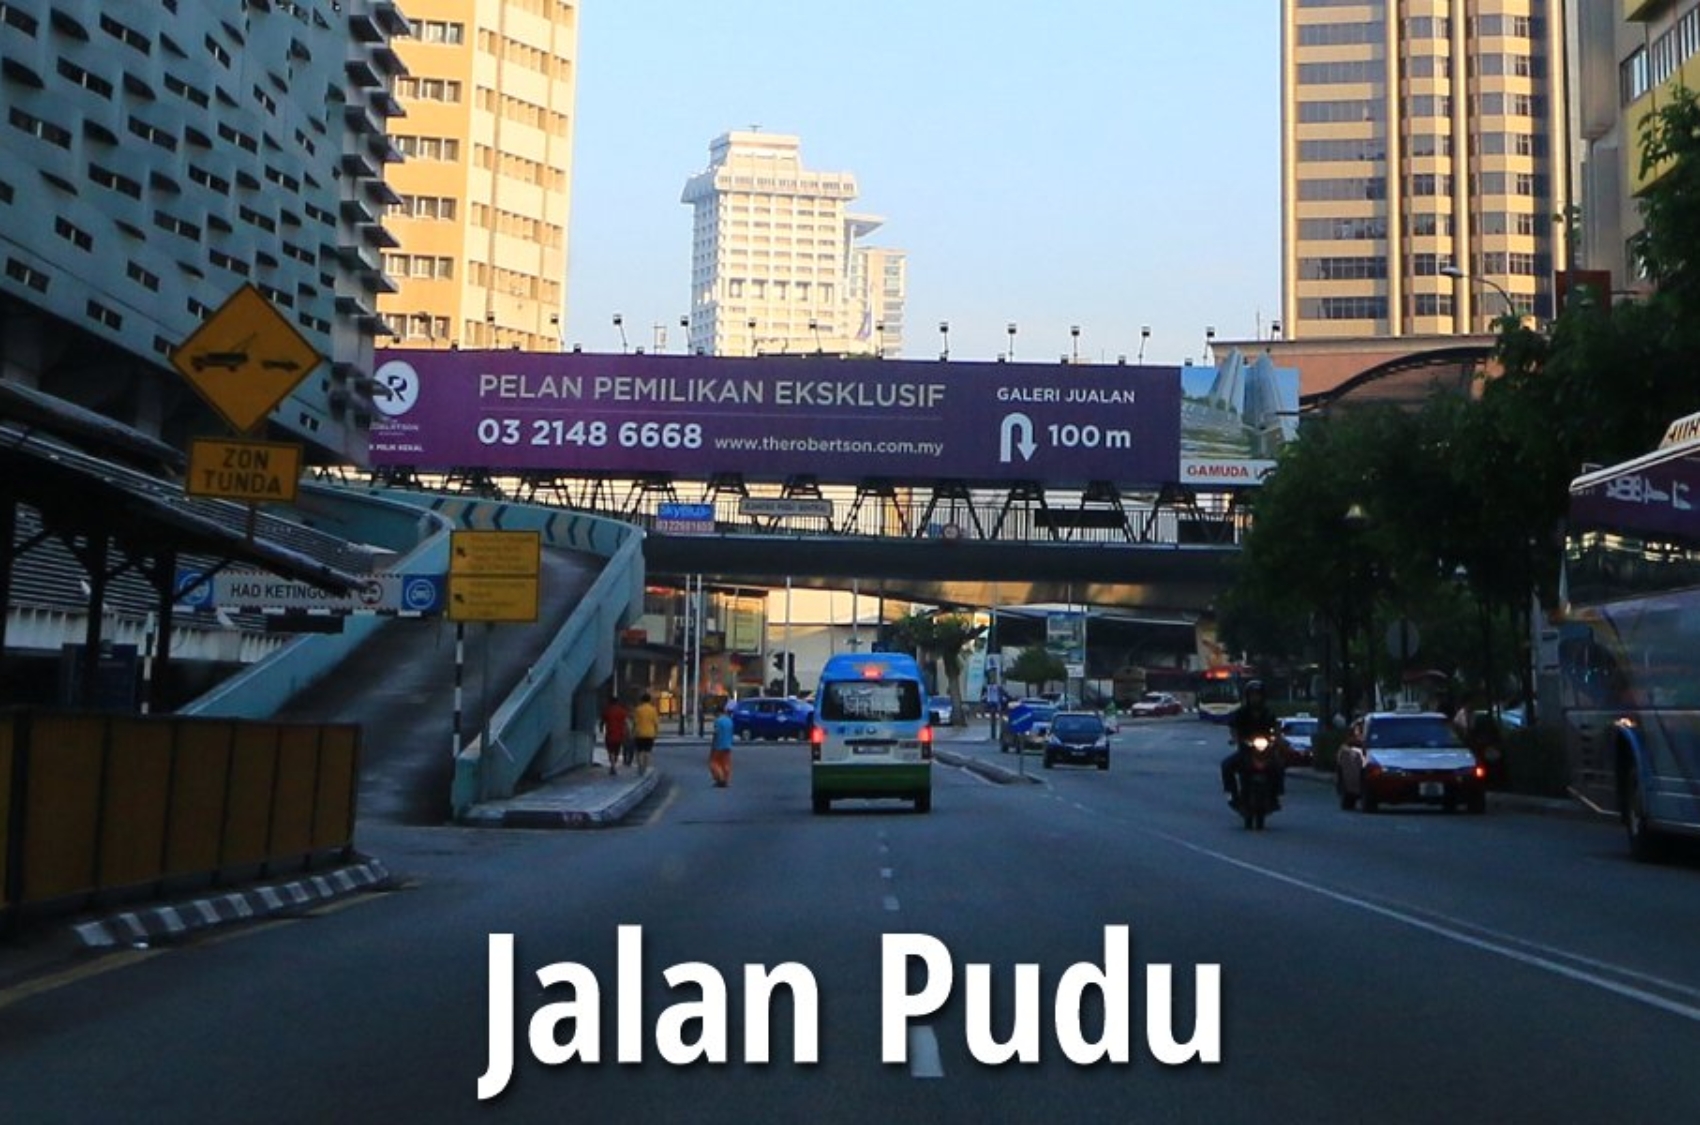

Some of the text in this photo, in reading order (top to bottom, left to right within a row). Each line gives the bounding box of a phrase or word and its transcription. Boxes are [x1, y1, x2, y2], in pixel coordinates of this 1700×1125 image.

[479, 374, 946, 408] PELAN PEMILIKAN EKSKLUSIF
[996, 387, 1135, 404] GALERI JUALAN
[477, 418, 703, 449] 03 2148 6668
[714, 436, 944, 457] www.therobertson.com.my
[222, 447, 270, 471] ZON
[203, 468, 283, 495] TUNDA
[1187, 464, 1249, 478] GAMUDA
[230, 583, 261, 598] HAD
